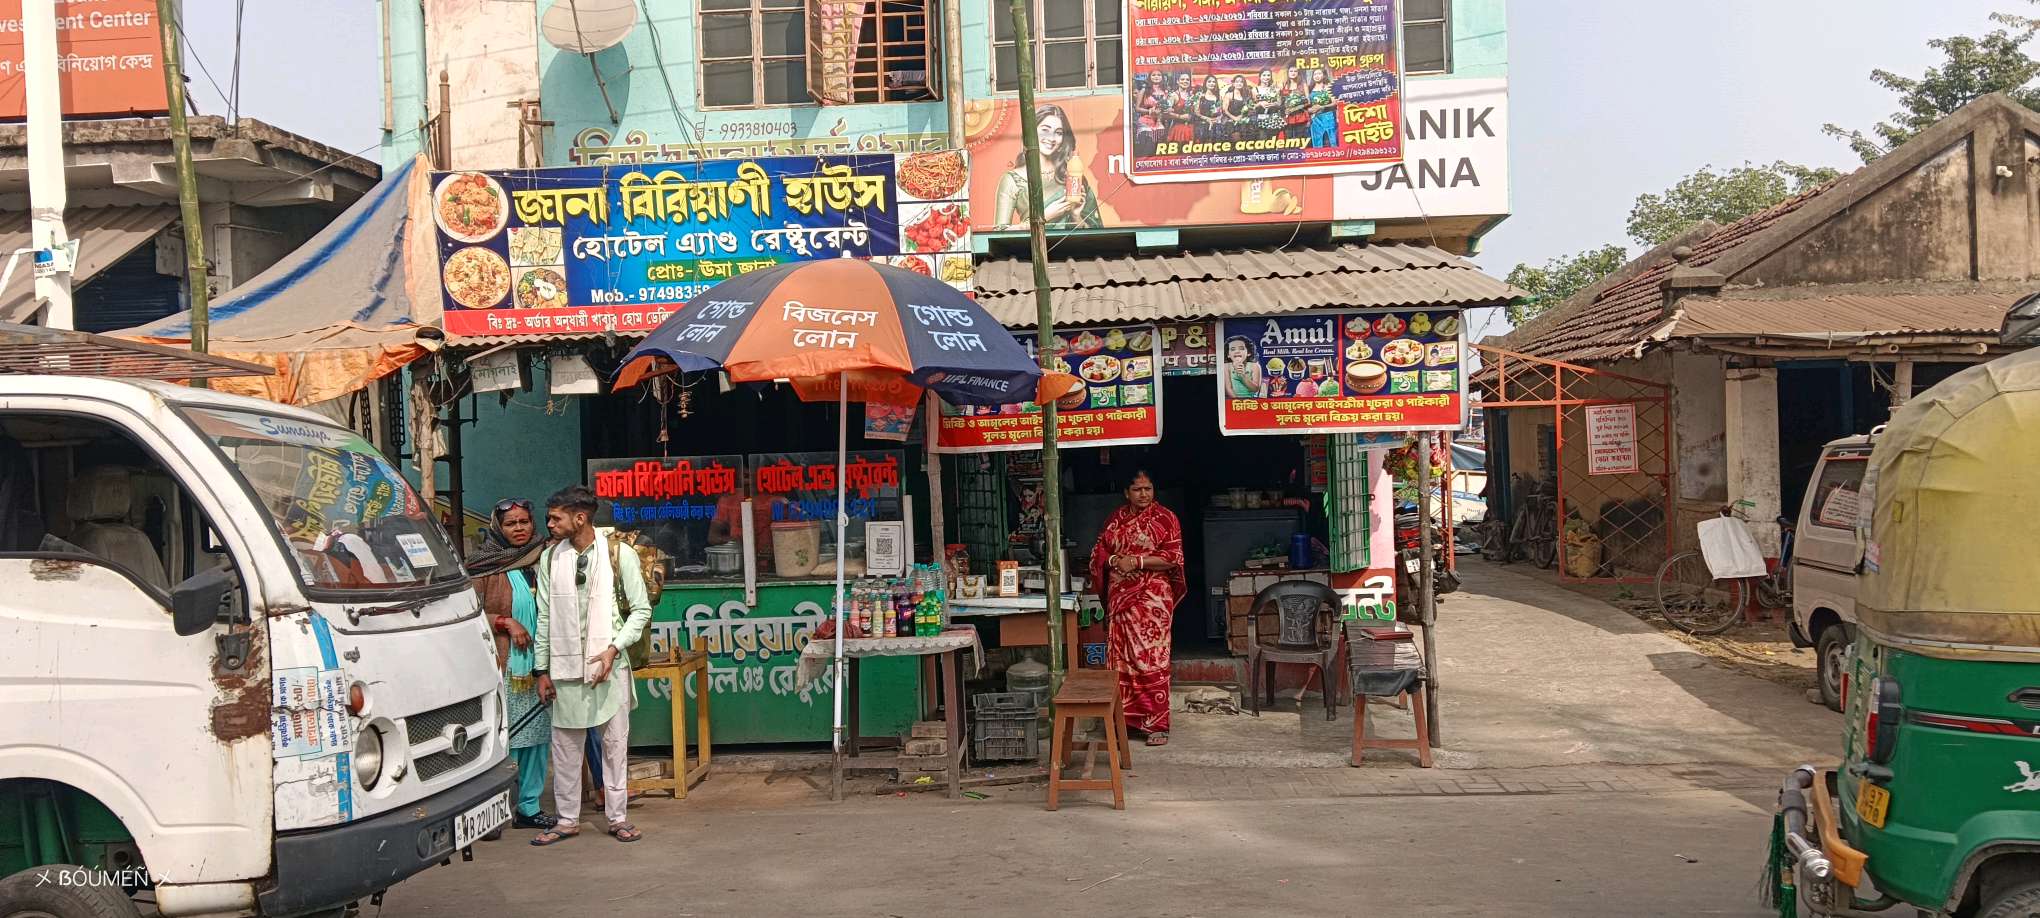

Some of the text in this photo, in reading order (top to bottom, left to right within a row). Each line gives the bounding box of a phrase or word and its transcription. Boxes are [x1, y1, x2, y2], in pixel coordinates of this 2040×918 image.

[89, 11, 152, 29] Center
[57, 53, 154, 73] বিনিয়োগ কেন্দ্র
[1343, 102, 1388, 125] দিশা
[1406, 107, 1495, 140] NIK
[1342, 121, 1394, 146] নাইট
[1155, 135, 1312, 156] RB dance academy
[512, 186, 609, 226] জানা
[782, 164, 886, 216] হাউস
[572, 231, 668, 261] হোটেল
[751, 221, 871, 257] রেষ্টুরেন্ট
[698, 259, 733, 277] উমা
[523, 312, 551, 328] অর্ডার
[553, 309, 589, 331] অনুযায়ী
[621, 312, 642, 326] হোম
[697, 300, 755, 320] গোল্ড
[781, 301, 879, 328] বিজনেস
[907, 303, 974, 328] গোল্ড
[676, 322, 727, 344] লোন
[793, 328, 859, 349] লোন
[927, 331, 988, 352] লোন
[1185, 325, 1207, 348] &
[1260, 319, 1335, 347] Amul
[968, 376, 1009, 393] FINANCE
[1260, 402, 1269, 411] ও
[1366, 398, 1393, 411] খুচরা
[1395, 398, 1404, 408] ও
[1406, 393, 1450, 408] পাইকারী
[968, 419, 976, 428] ও
[1068, 413, 1094, 426] খুচরা
[1096, 413, 1104, 423] ও
[1105, 408, 1147, 423] পাইকারী
[1360, 412, 1383, 423] করা
[1063, 426, 1085, 438] করা
[595, 468, 633, 497] জানা
[697, 461, 736, 496] হাউস
[756, 457, 804, 493] হোটেল
